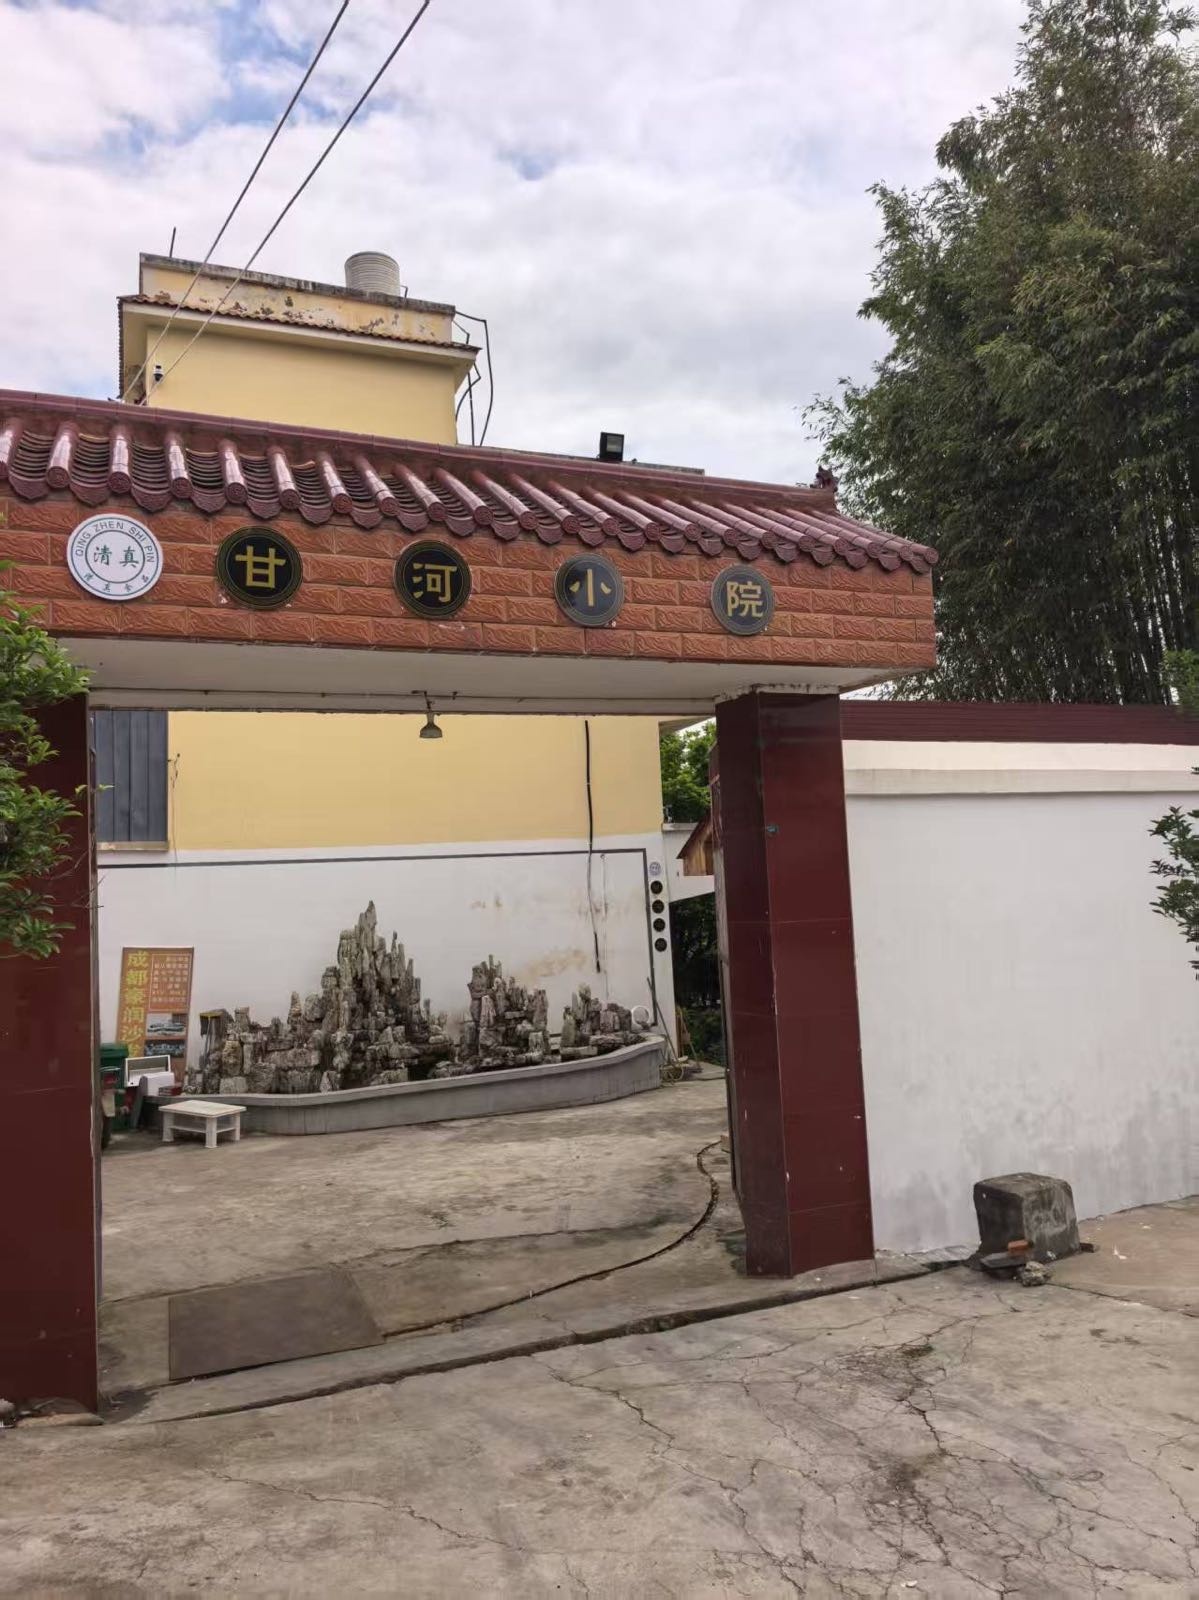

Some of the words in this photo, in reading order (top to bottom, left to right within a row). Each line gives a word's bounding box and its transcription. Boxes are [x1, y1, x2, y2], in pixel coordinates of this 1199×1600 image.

[75, 532, 91, 557] QING
[93, 521, 125, 532] ZHEN
[129, 526, 146, 542] SHI
[144, 545, 155, 563] PIN
[94, 544, 139, 568] 清真
[235, 545, 763, 617] 甘河小院
